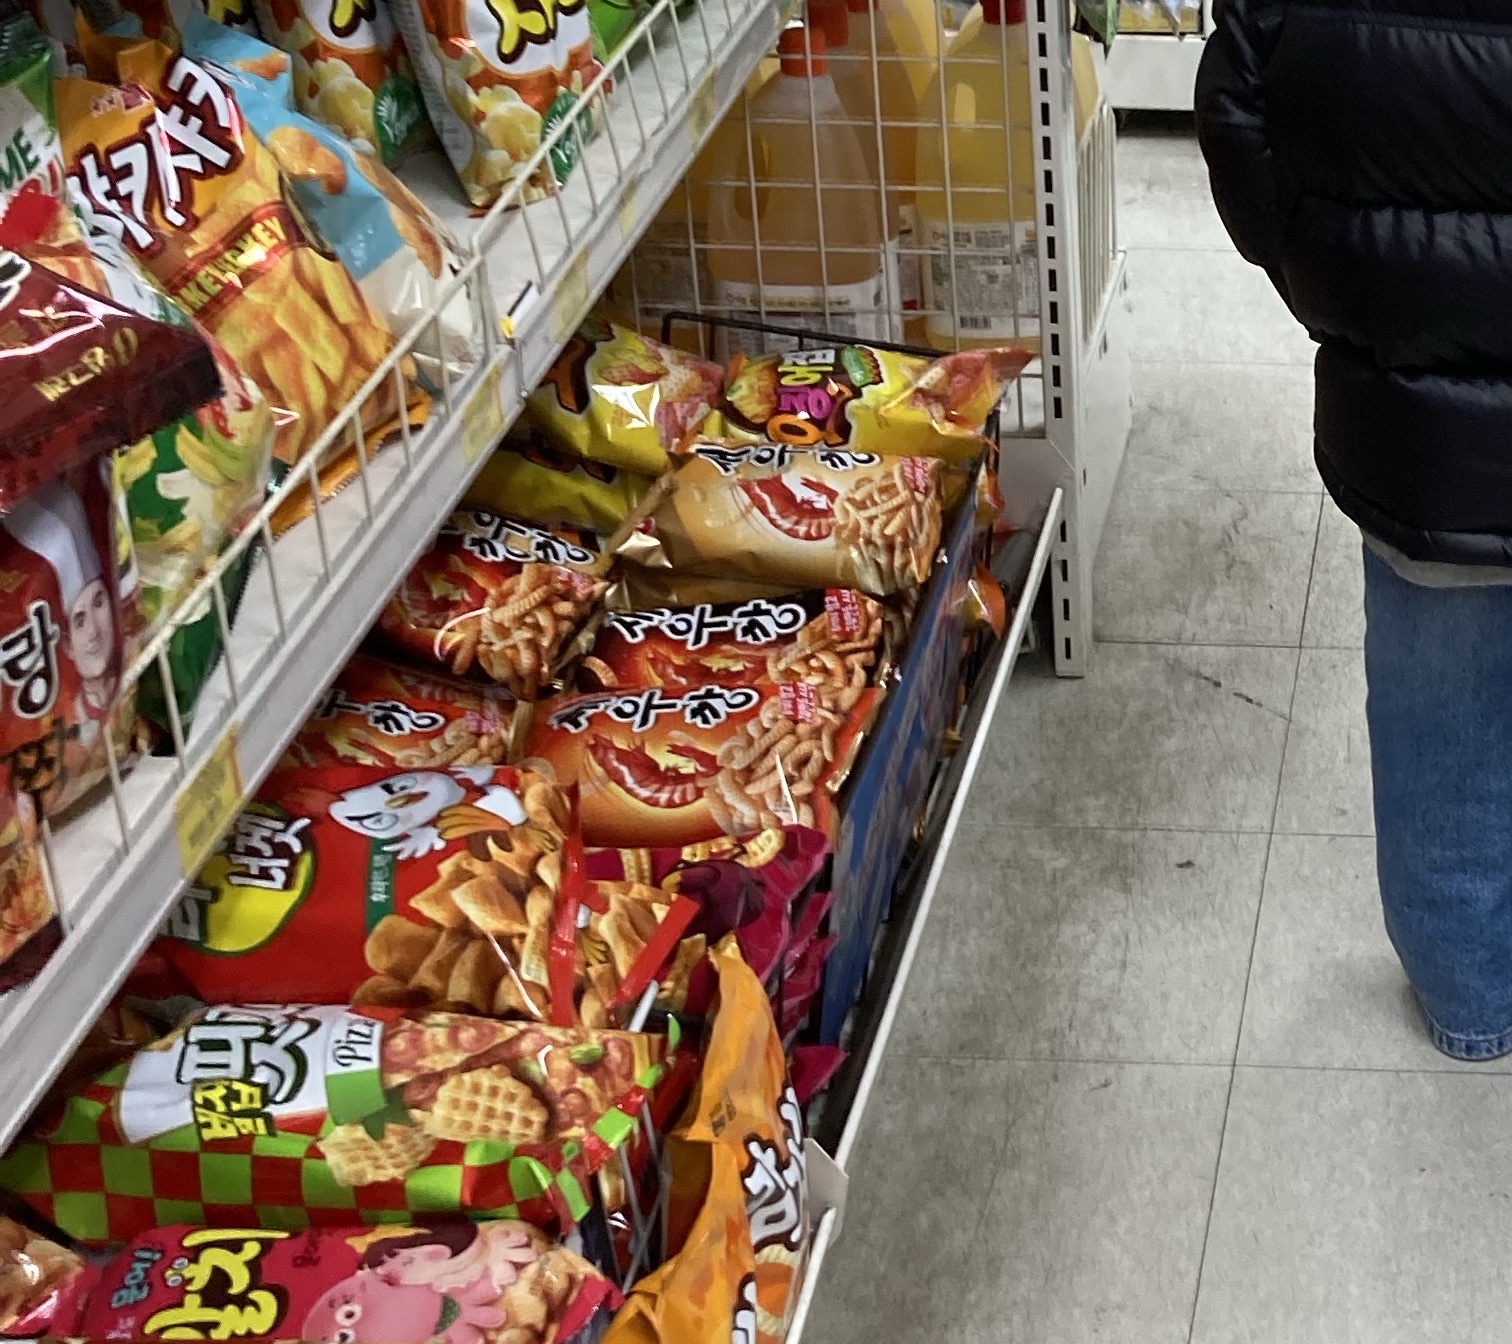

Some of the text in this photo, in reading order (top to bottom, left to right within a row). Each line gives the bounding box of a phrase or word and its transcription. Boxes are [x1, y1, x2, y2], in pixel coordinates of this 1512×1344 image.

[610, 601, 807, 650] 새우깡
[548, 686, 760, 736] 새우깡
[193, 1078, 279, 1142] 벌집
